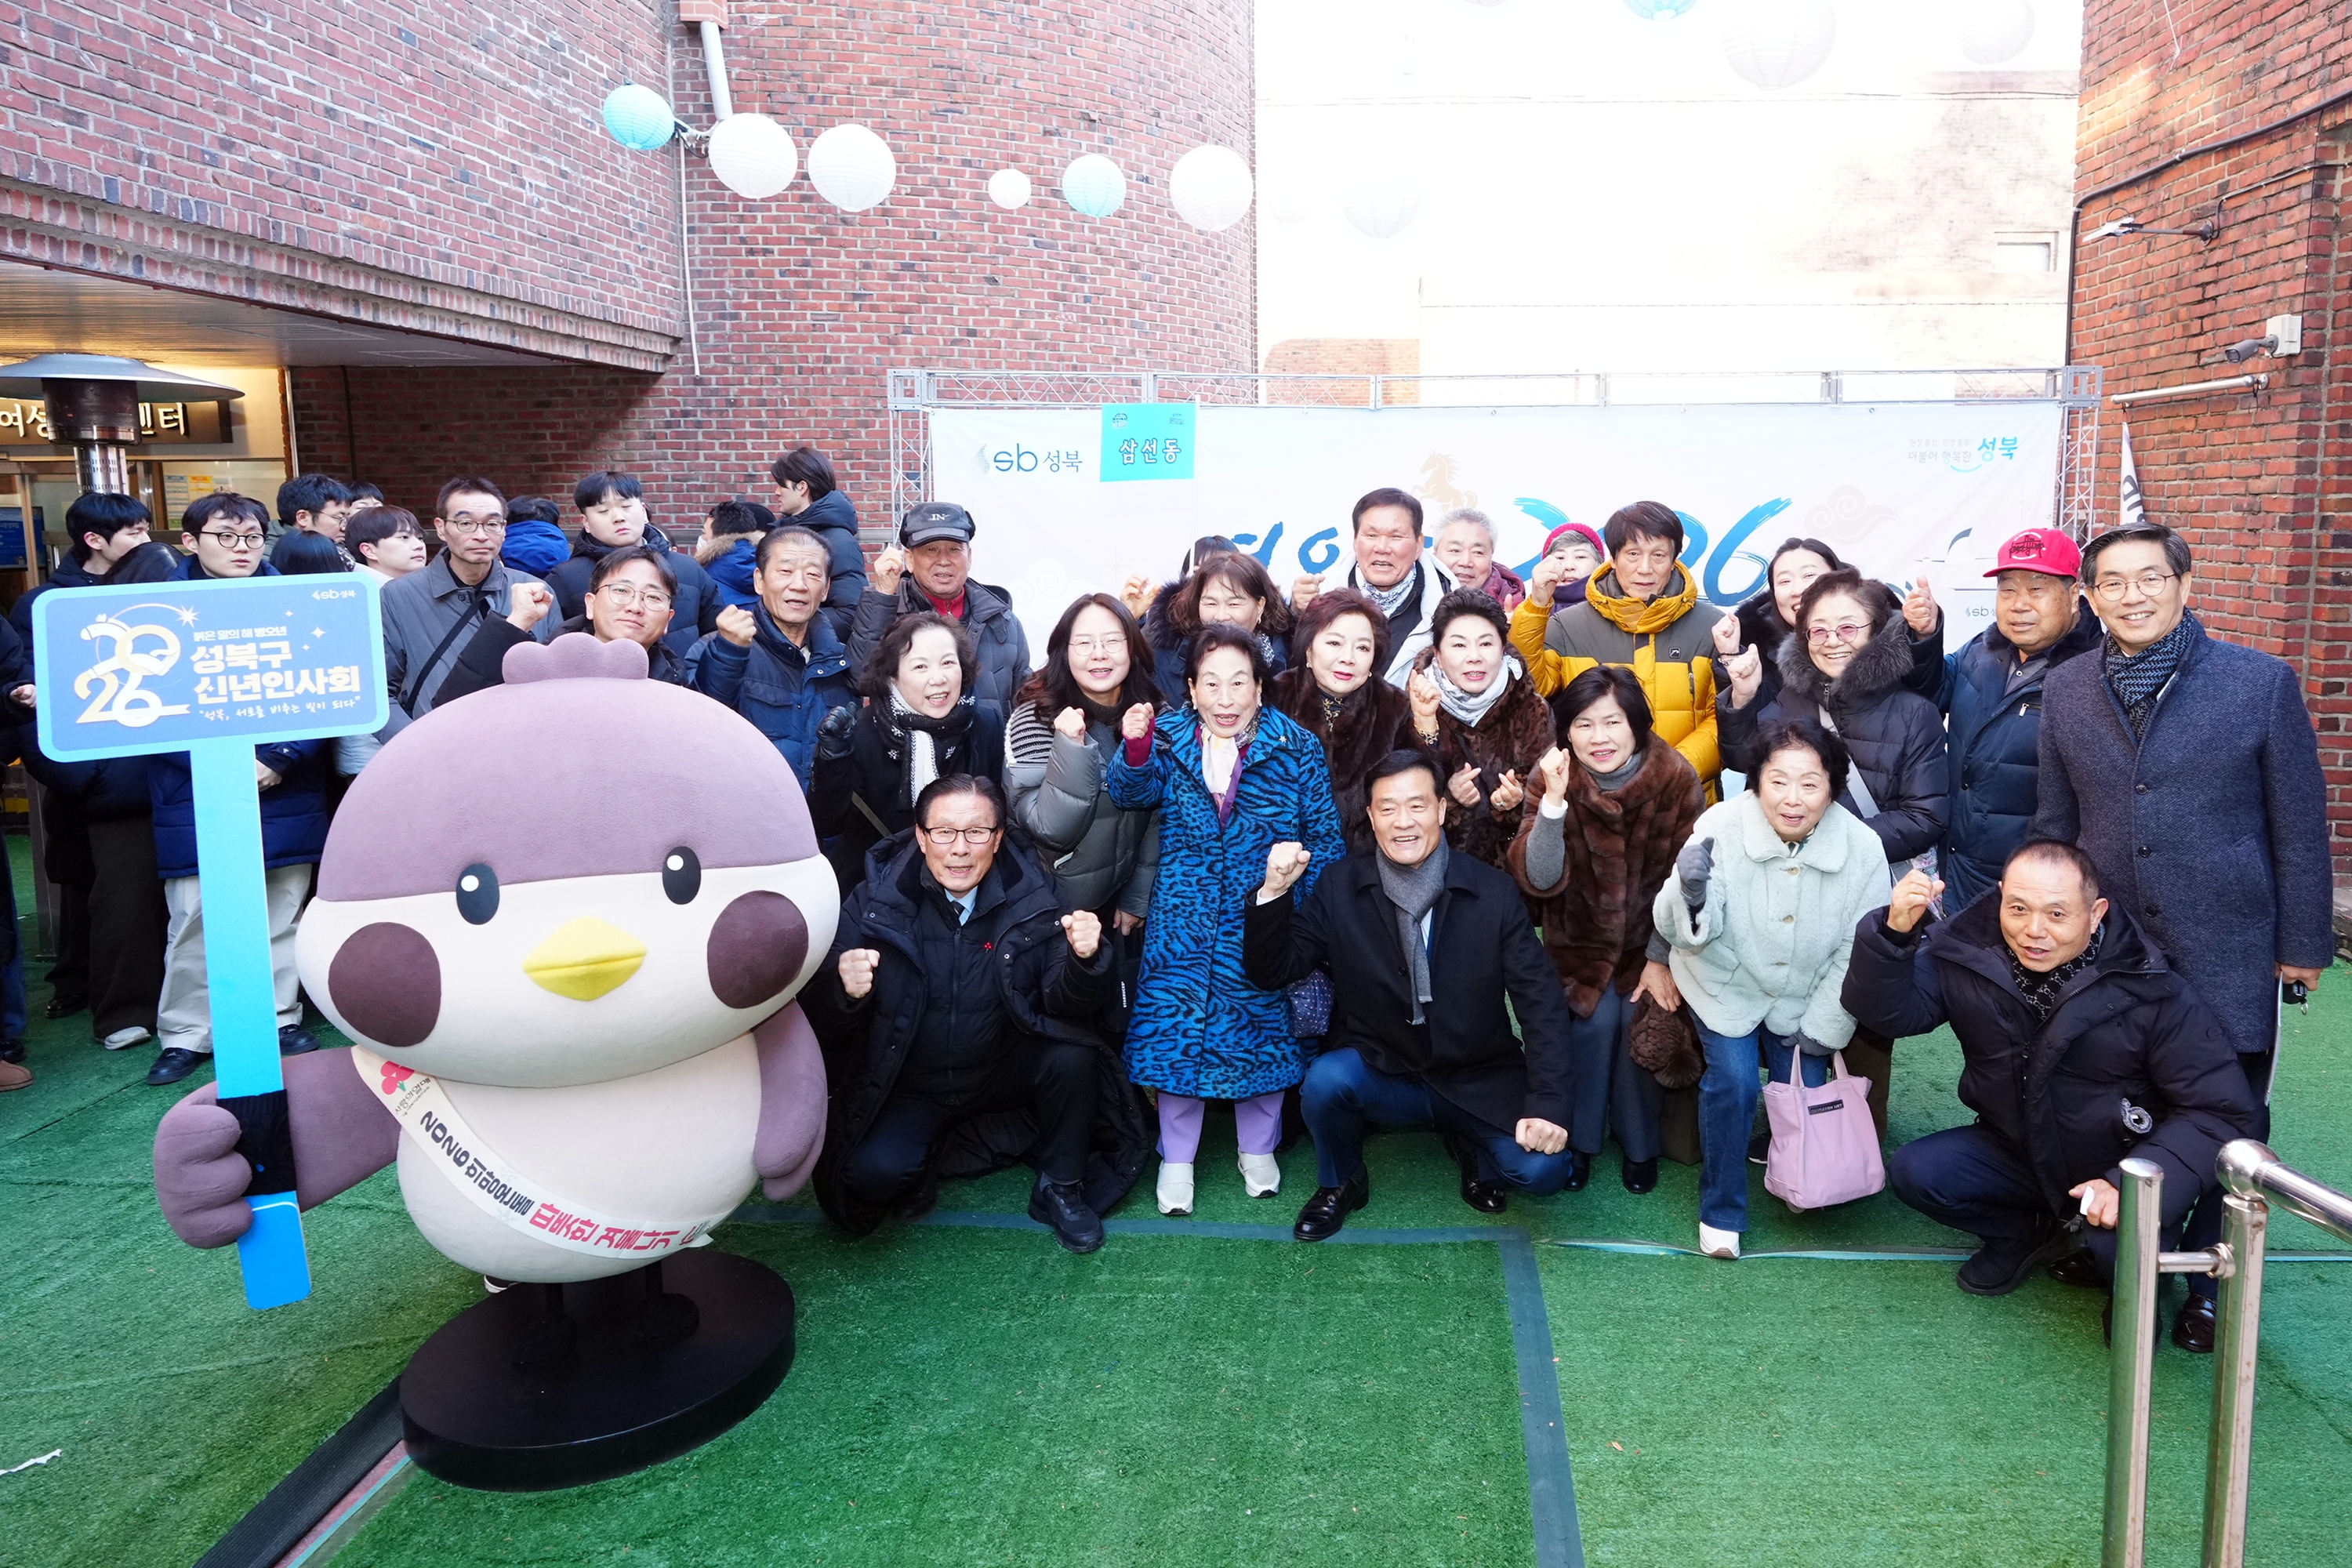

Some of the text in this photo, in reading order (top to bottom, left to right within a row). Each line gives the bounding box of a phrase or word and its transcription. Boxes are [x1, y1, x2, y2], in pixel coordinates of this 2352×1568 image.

[993, 443, 1083, 473] sb 성북
[1119, 437, 1181, 466] 삼선동
[1908, 436, 2019, 465] 더불어 행복한 성북
[321, 589, 356, 600] sb 성북
[1972, 605, 1989, 617] sb
[193, 626, 288, 642] 붉은 말의 해 병오년
[190, 641, 292, 674] 성북구
[193, 666, 361, 705] 신년인사회
[236, 705, 265, 719] 서로를
[270, 702, 301, 715] 비추는
[420, 1111, 470, 1160] 2026
[465, 1157, 535, 1216] 희망온돌
[529, 1203, 601, 1243] 따뜻한
[593, 1225, 681, 1250] 겨울나기
